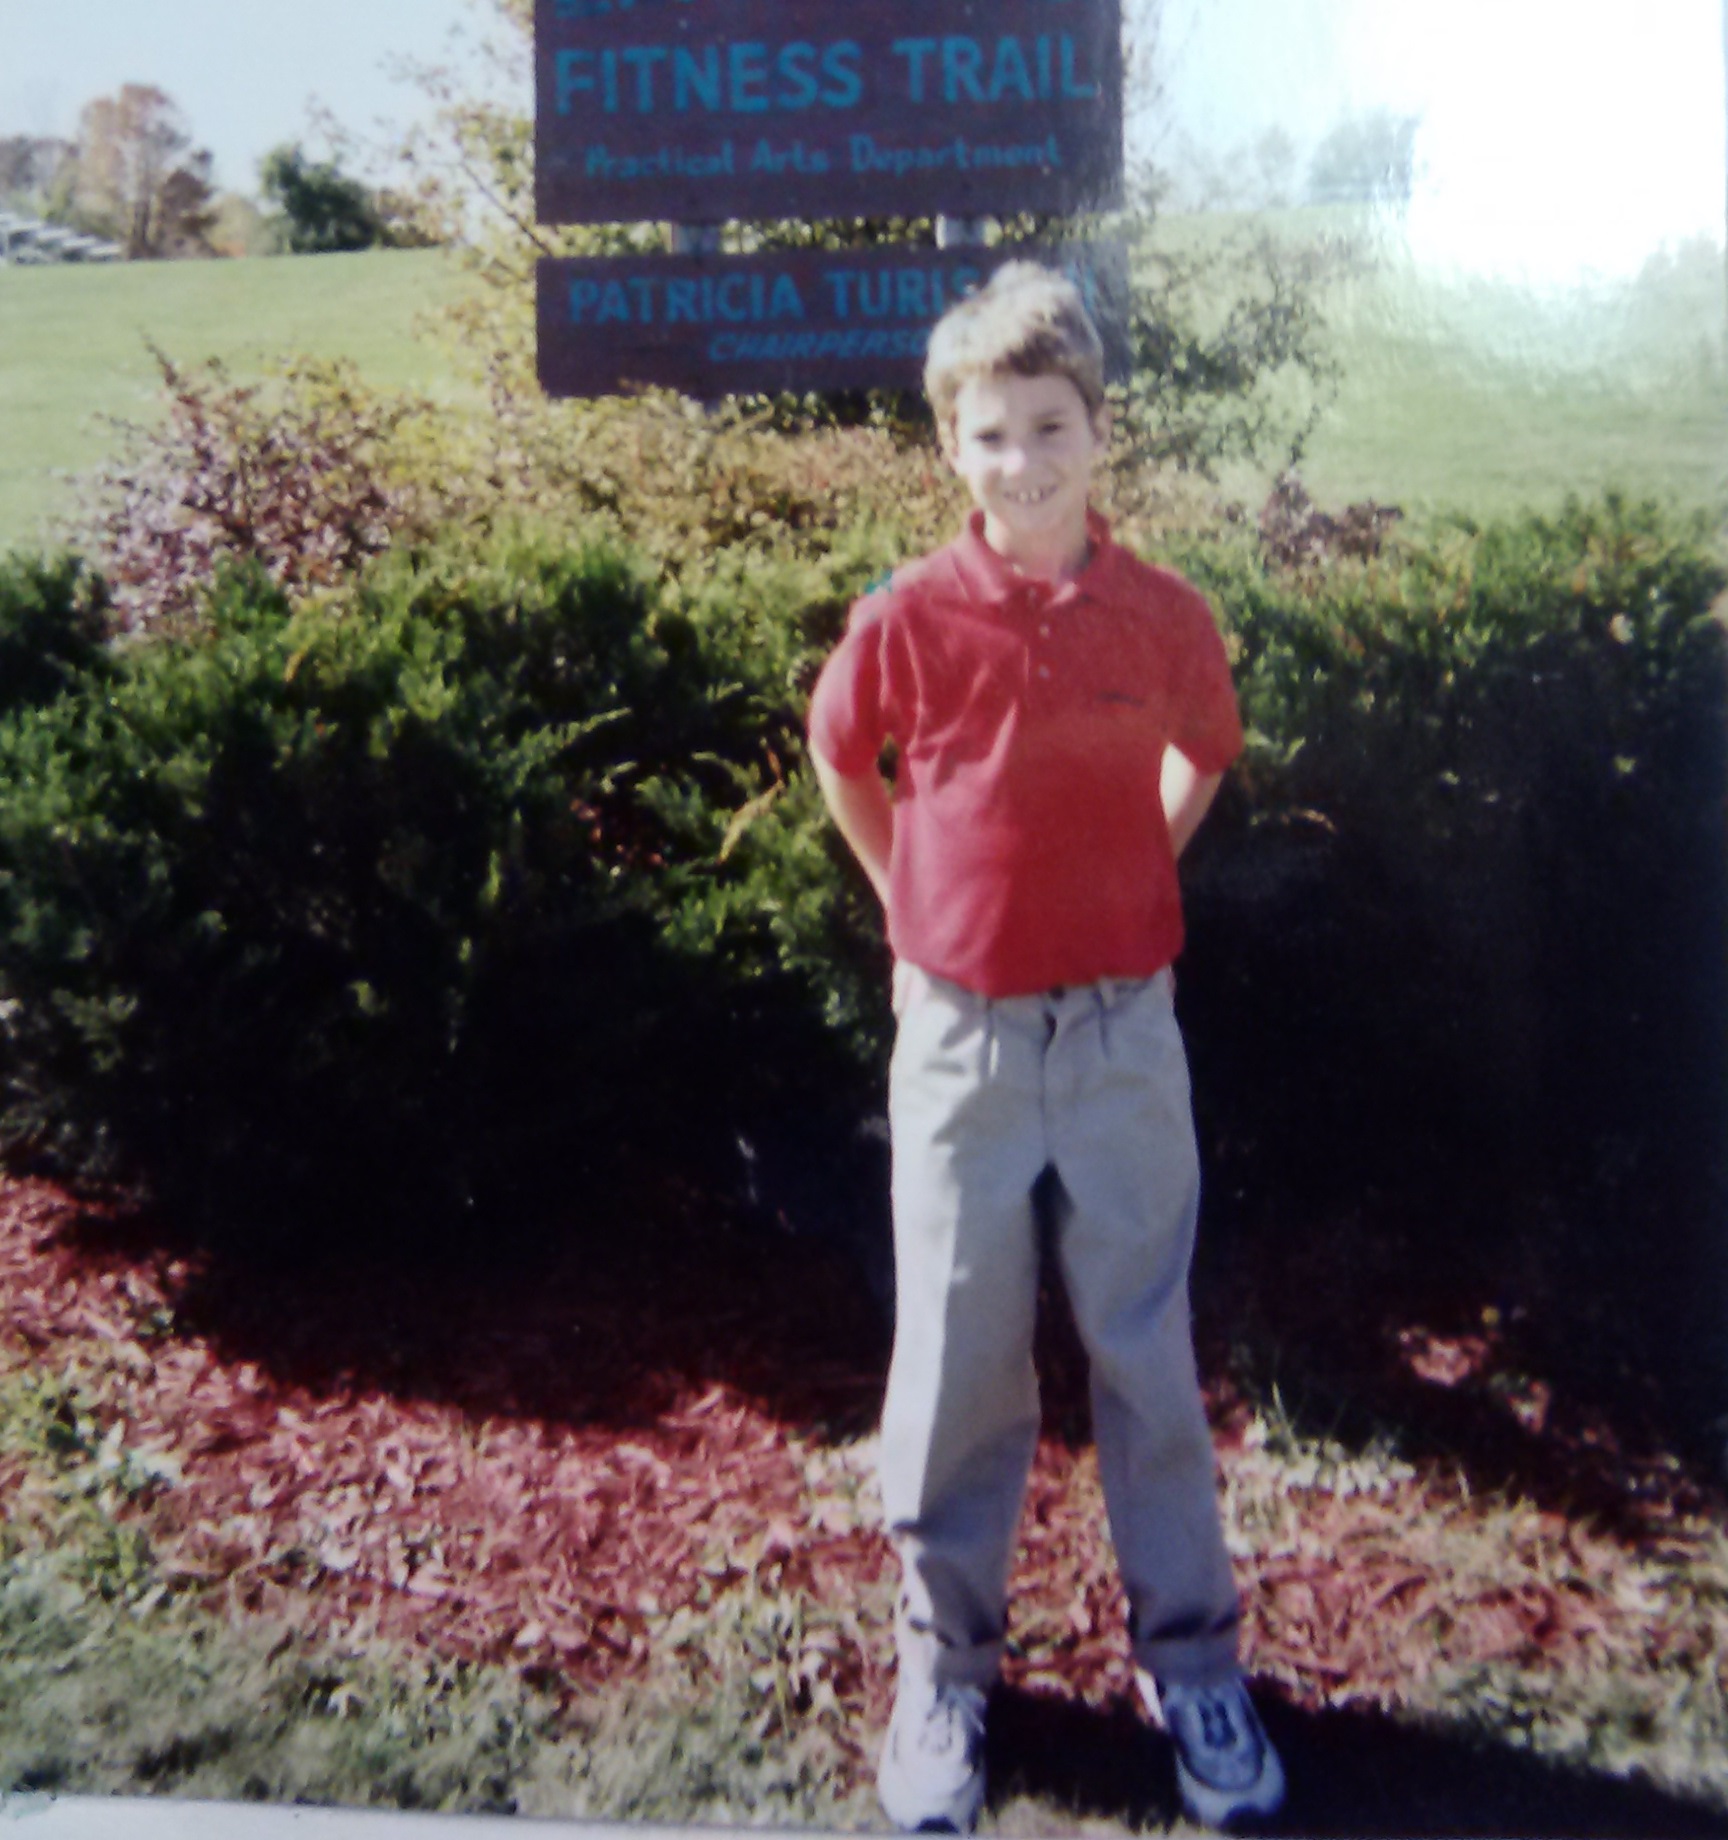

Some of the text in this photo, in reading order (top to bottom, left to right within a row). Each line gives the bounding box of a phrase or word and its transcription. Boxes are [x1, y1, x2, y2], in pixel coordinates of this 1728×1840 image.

[555, 33, 1096, 115] FITNESS TRAIL
[584, 138, 735, 178] Practical
[751, 137, 829, 174] Arts
[570, 272, 804, 324] PATRICIA
[707, 325, 930, 363] CHAIRPERSO
